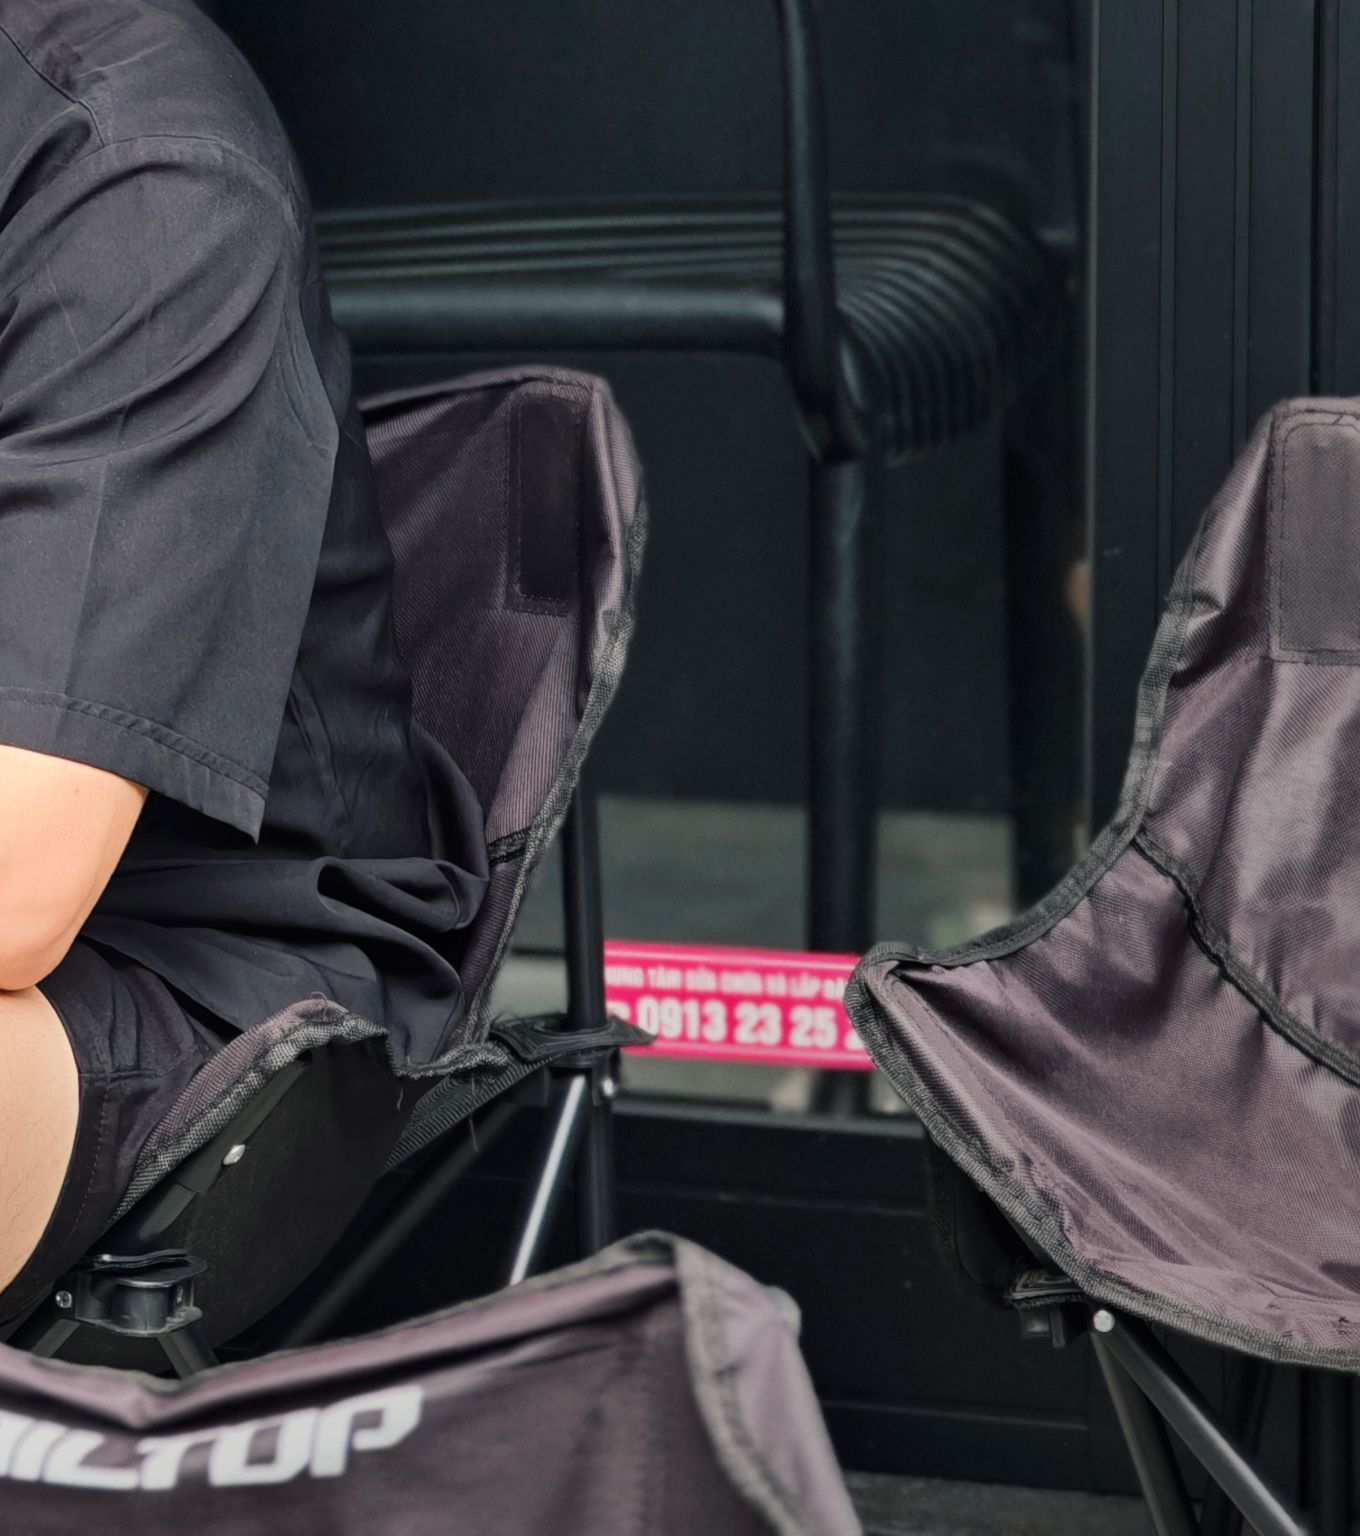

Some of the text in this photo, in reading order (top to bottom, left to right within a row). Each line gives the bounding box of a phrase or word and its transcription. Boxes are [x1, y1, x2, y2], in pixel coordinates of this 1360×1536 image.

[636, 996, 728, 1042] 0913
[734, 1002, 782, 1045] 23
[789, 1004, 838, 1049] 25
